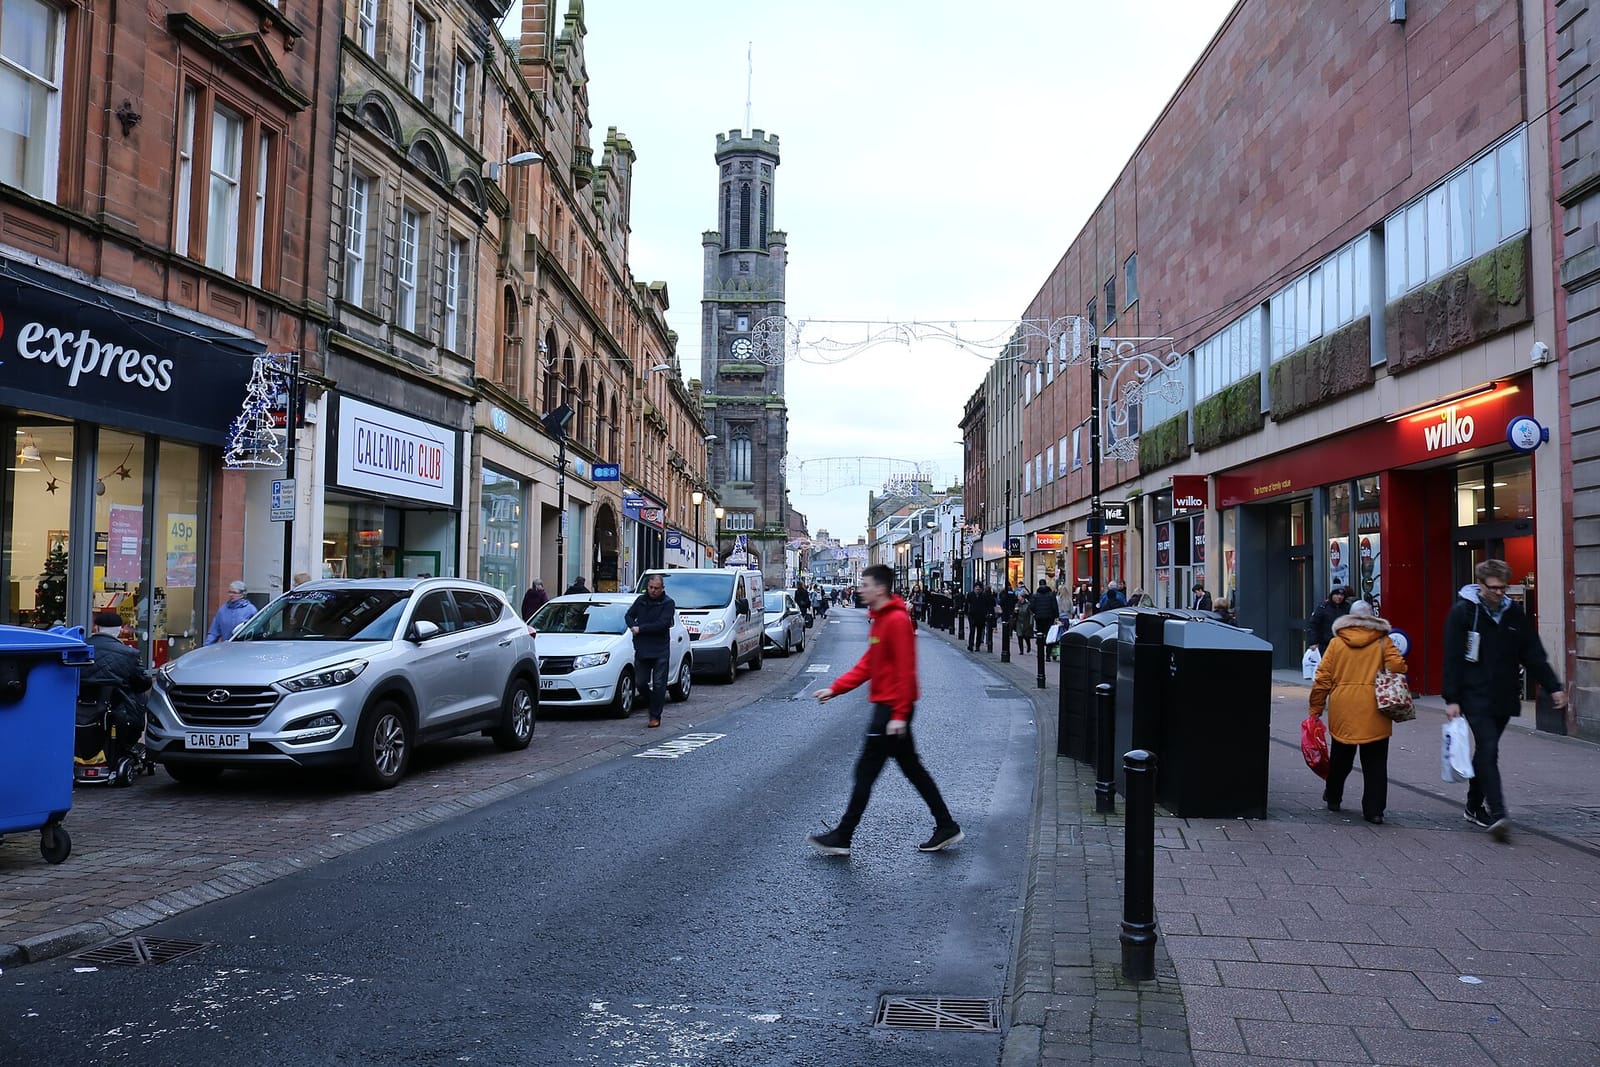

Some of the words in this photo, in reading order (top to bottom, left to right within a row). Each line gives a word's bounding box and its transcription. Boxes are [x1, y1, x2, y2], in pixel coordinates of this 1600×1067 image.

[17, 322, 174, 392] express
[1424, 406, 1474, 452] wilko
[357, 427, 414, 475] CALENDAR
[418, 443, 441, 481] CLUB
[1176, 495, 1203, 506] wilko
[171, 522, 193, 541] 49p
[191, 734, 216, 746] CA16
[218, 734, 241, 746] AOF
